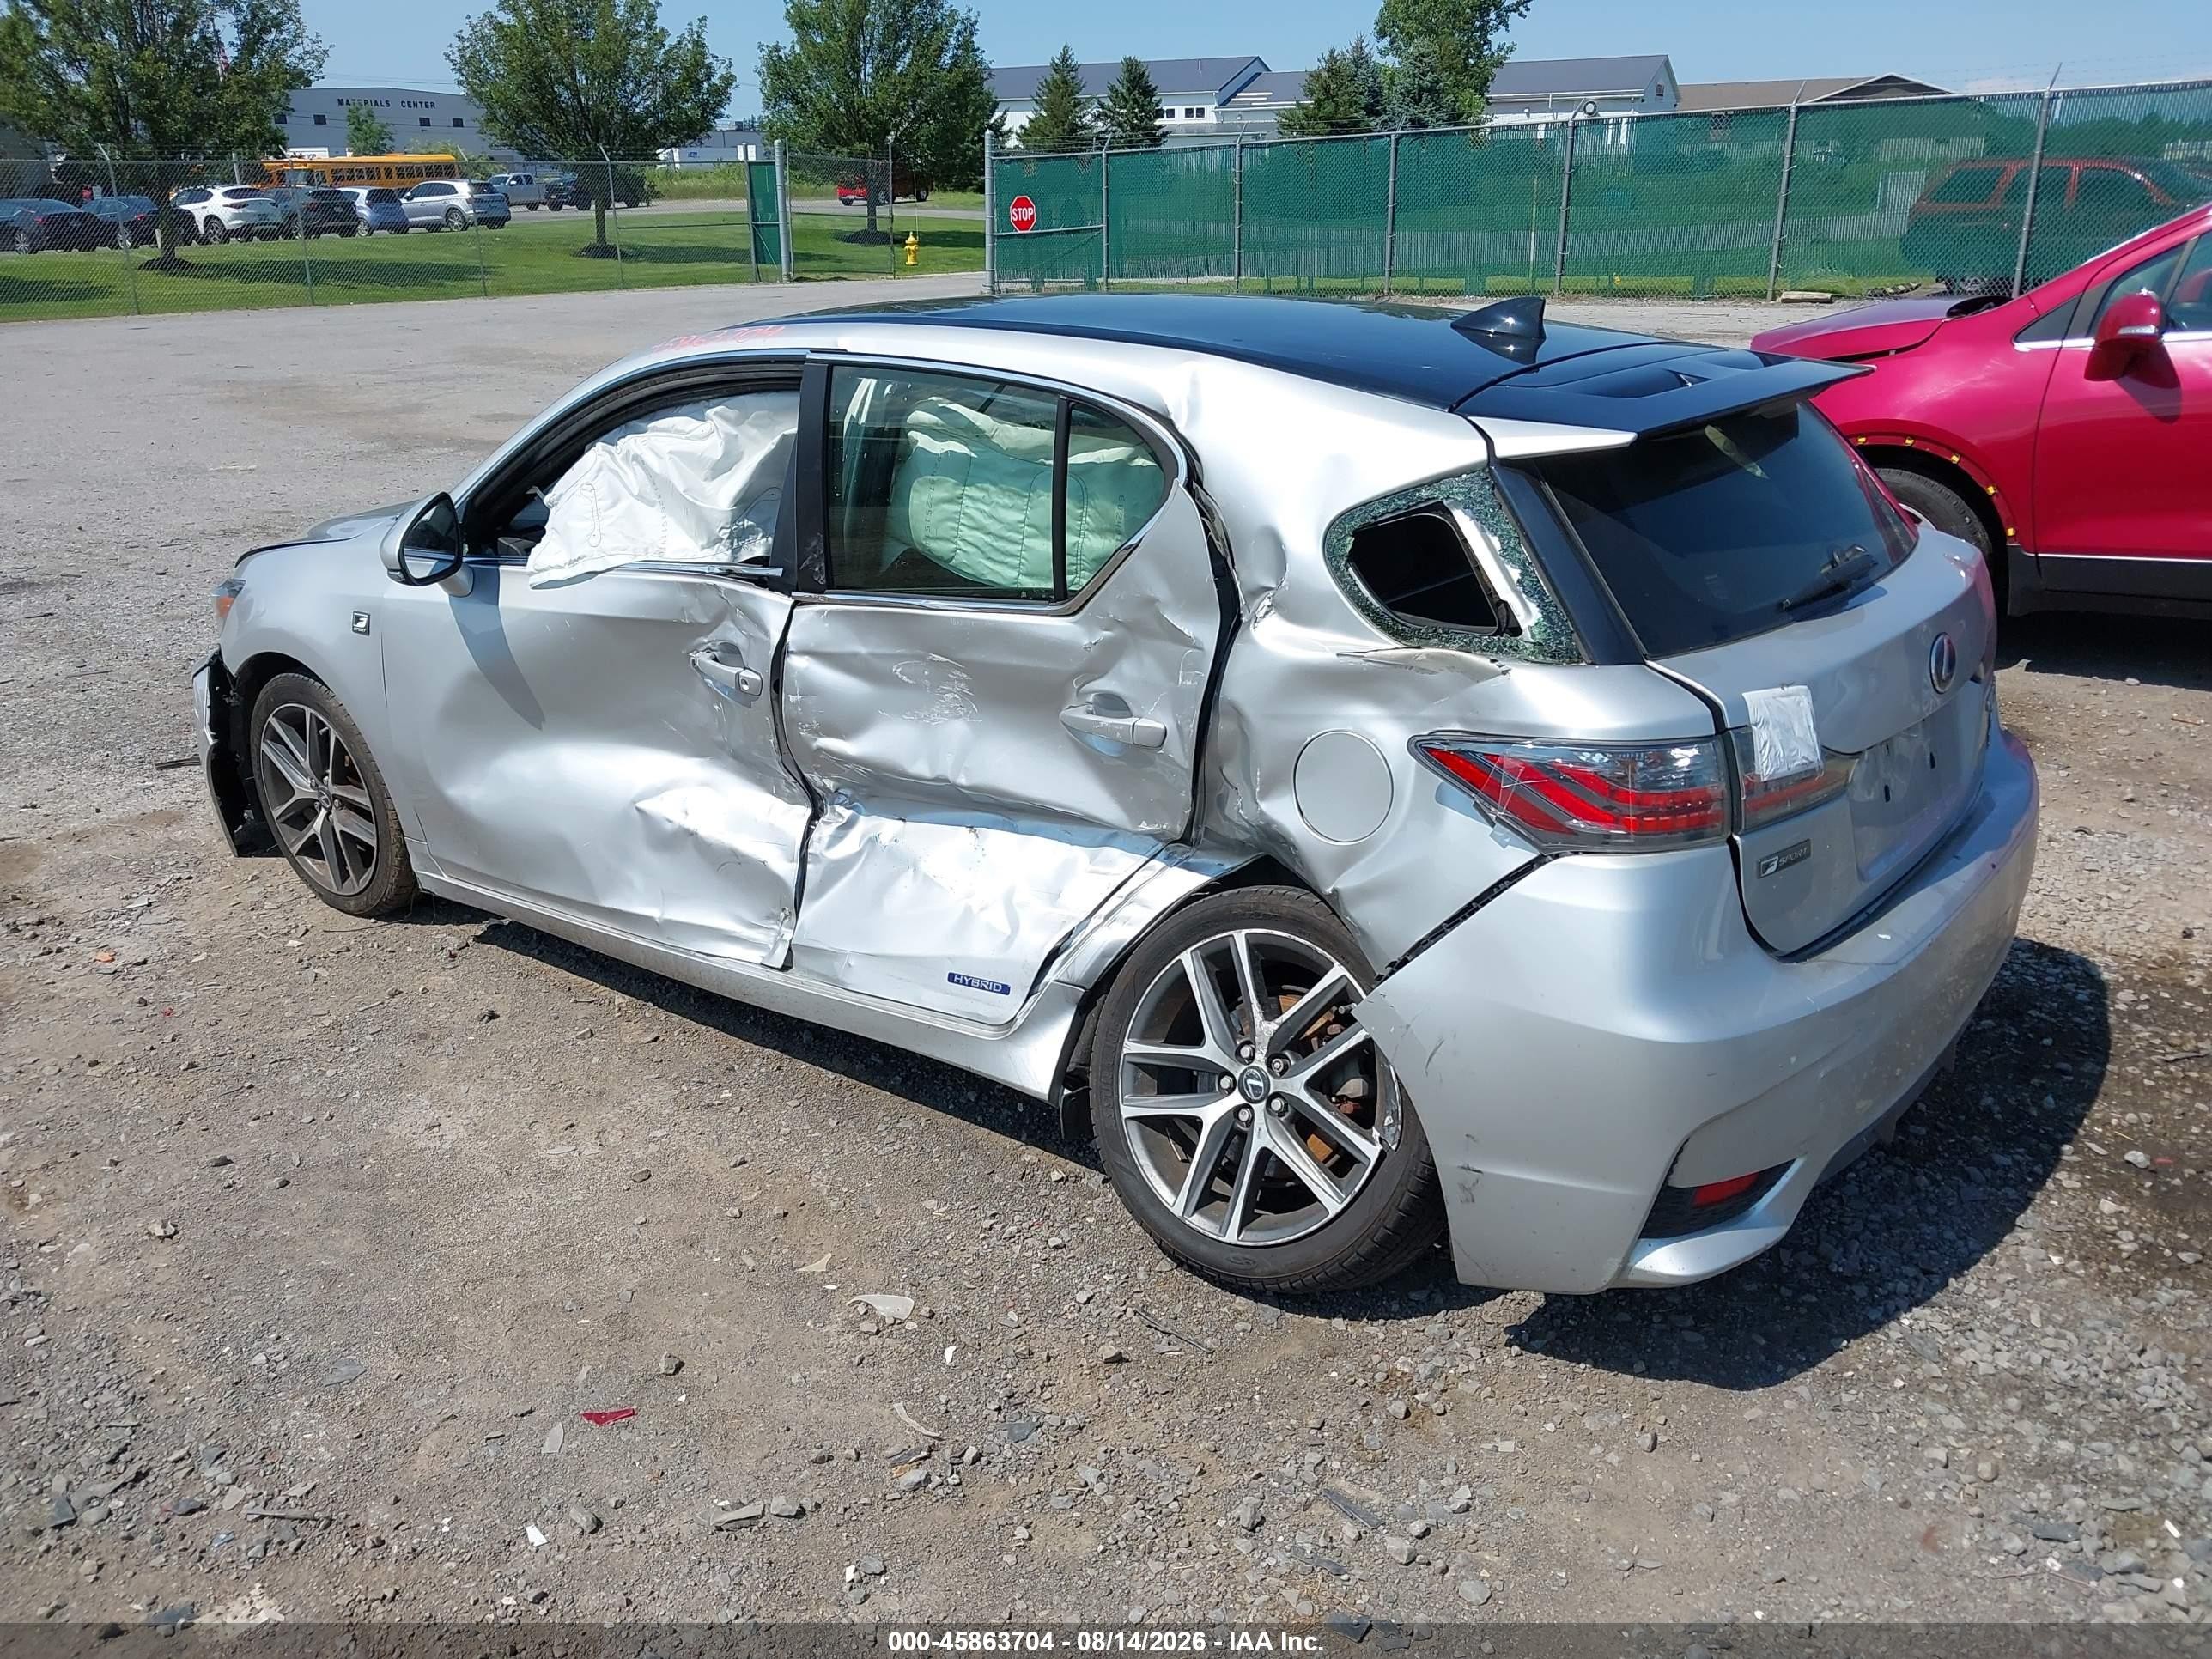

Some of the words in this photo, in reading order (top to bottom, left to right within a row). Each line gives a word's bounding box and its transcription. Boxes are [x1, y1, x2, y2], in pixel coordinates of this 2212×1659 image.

[400, 100, 436, 109] CENTER
[1012, 206, 1035, 222] STOP
[952, 973, 1002, 993] HYBRID
